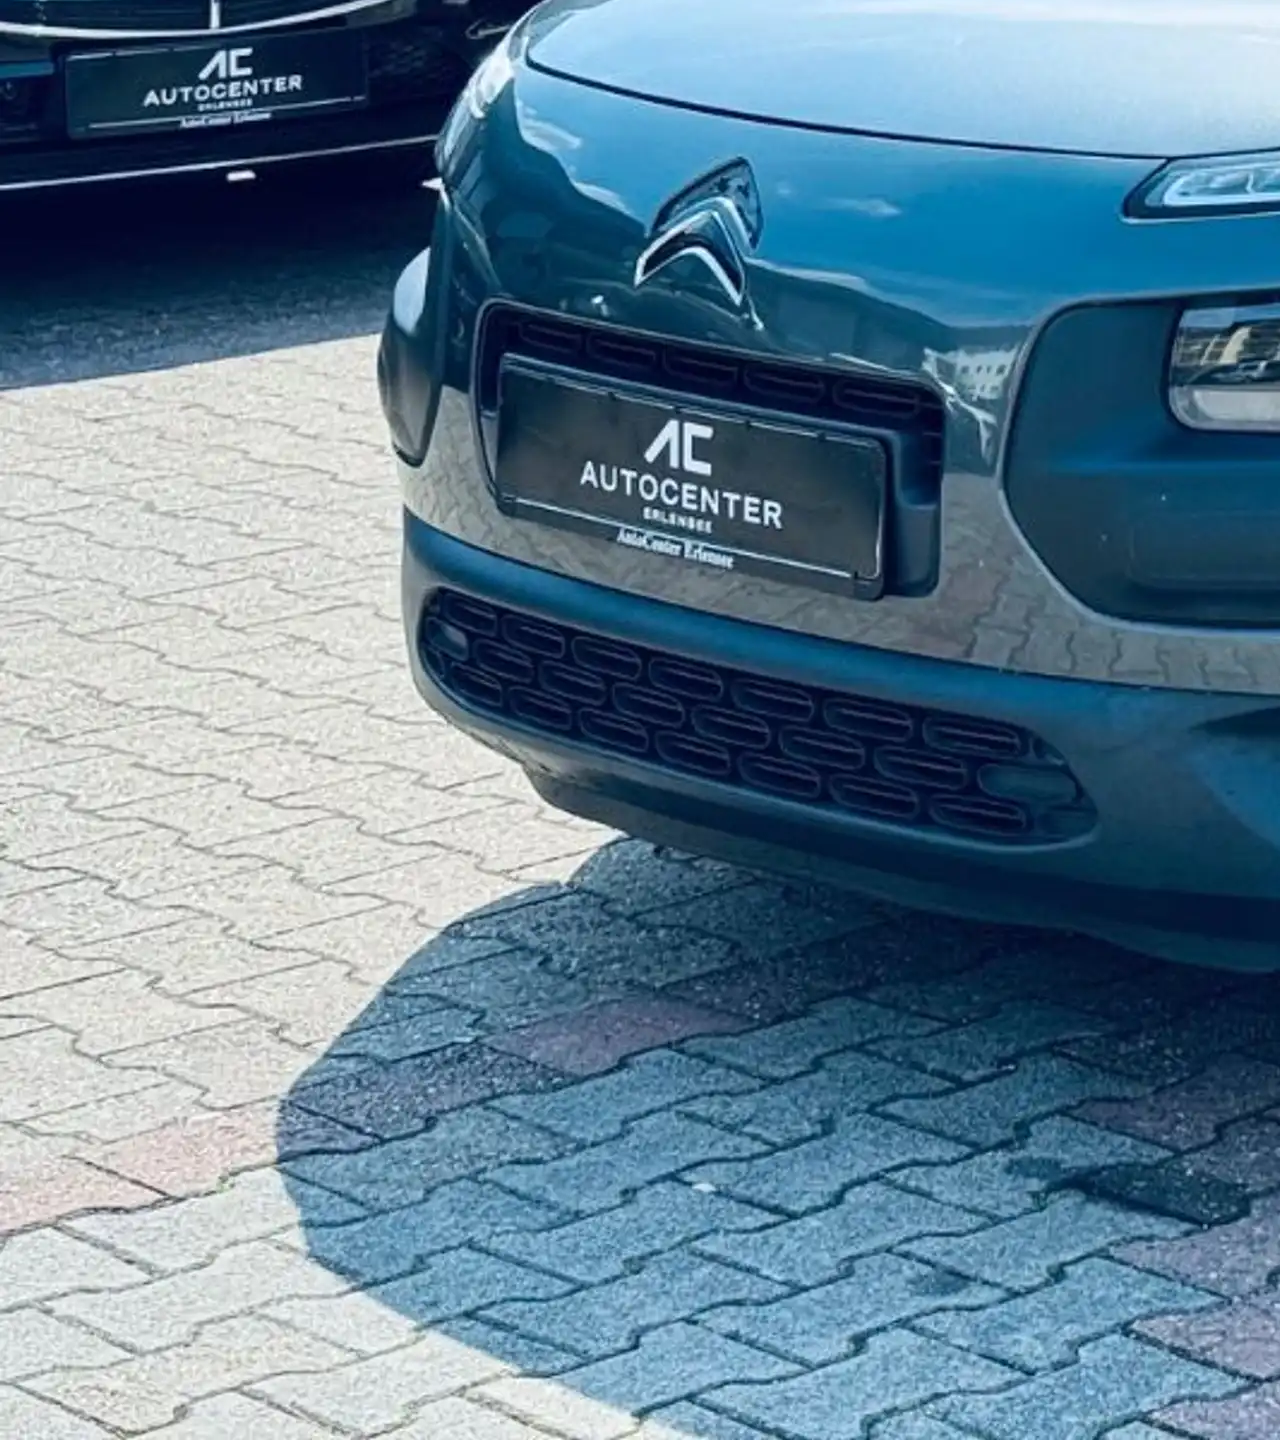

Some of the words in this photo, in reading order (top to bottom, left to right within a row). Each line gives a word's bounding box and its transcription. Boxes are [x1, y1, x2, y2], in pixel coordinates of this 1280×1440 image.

[143, 74, 302, 107] AUTOCENTER
[580, 460, 783, 529] AUTOCENTER
[643, 506, 712, 533] ERLENSEE
[617, 528, 682, 556] AutoCenter
[683, 540, 734, 570] Erlensee
